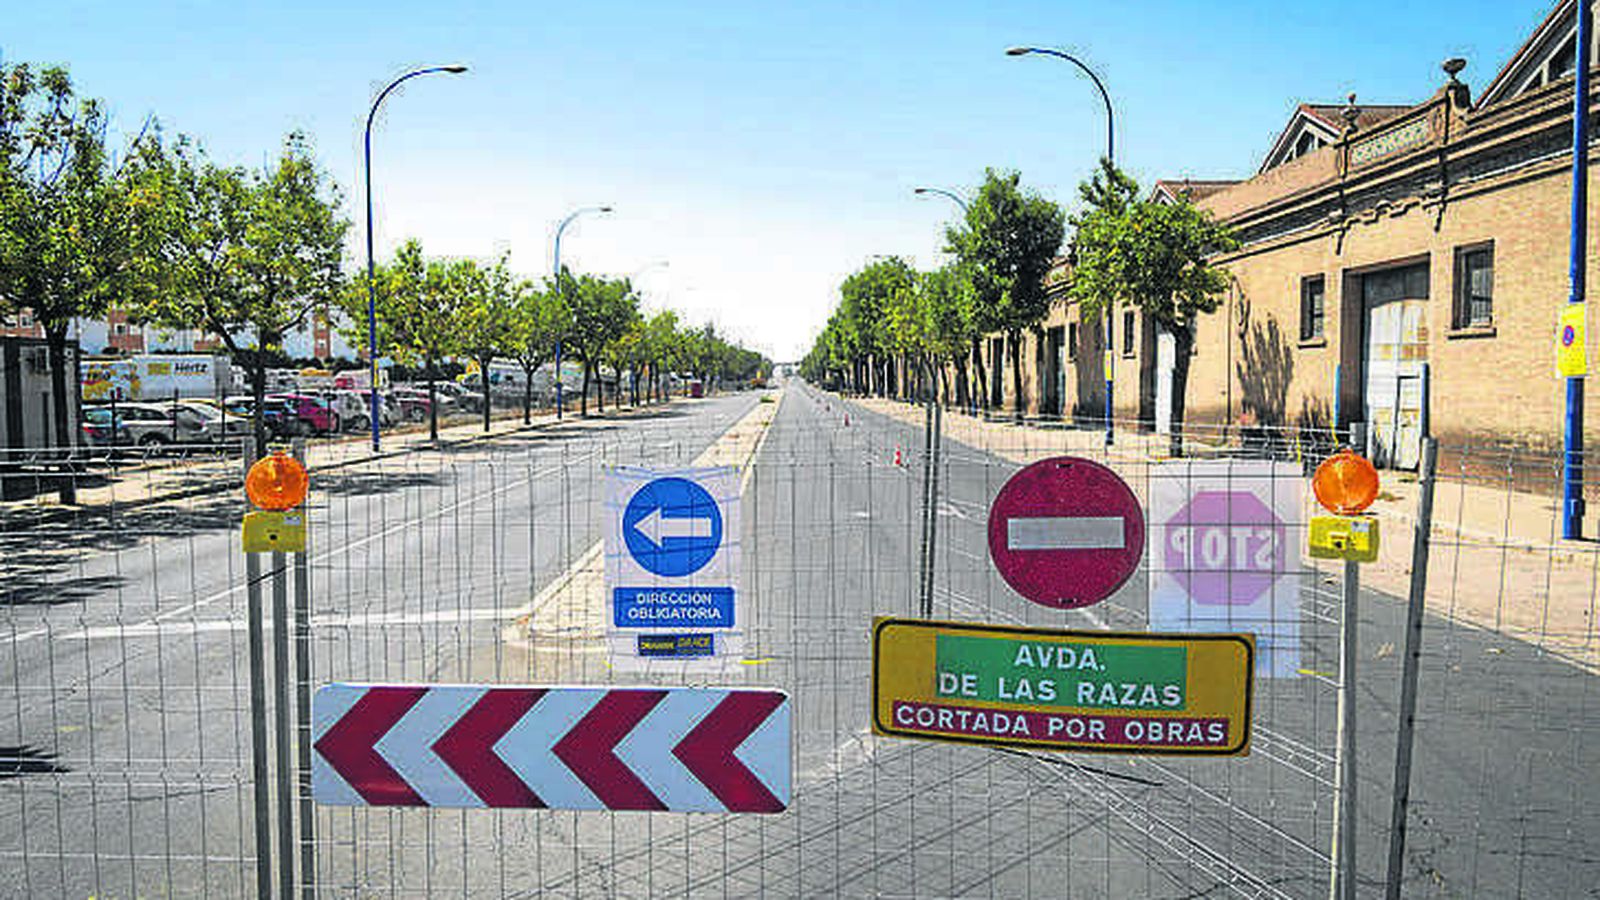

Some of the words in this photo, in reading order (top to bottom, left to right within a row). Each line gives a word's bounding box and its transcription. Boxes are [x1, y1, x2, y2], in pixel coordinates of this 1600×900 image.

[175, 362, 208, 373] Hertz
[628, 607, 722, 619] OBLIGATORIA
[1014, 644, 1107, 672] AVDA.
[938, 672, 979, 697] DE
[997, 676, 1057, 701] LAS
[1076, 681, 1182, 707] RAZAS
[895, 705, 1031, 736] CORTADA
[1047, 716, 1107, 741] POR
[1124, 720, 1225, 743] OBRAS
